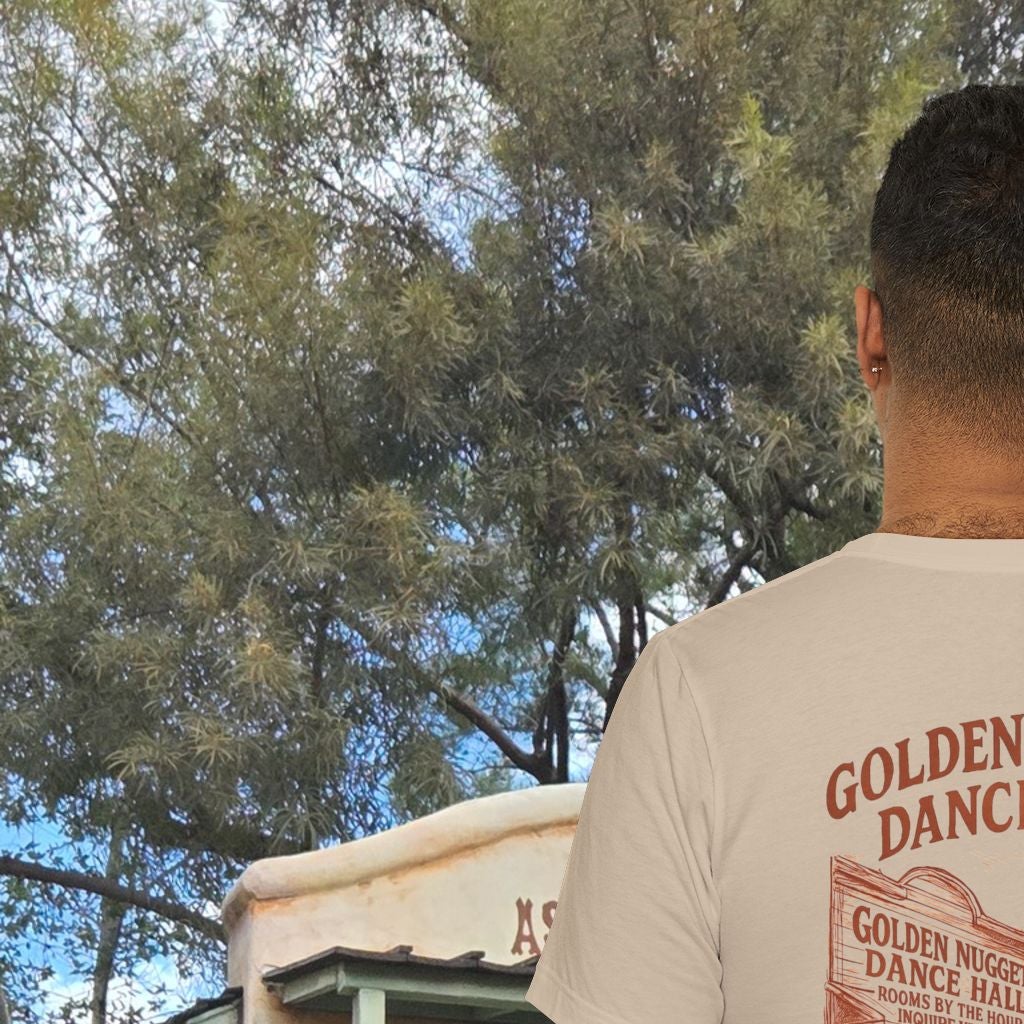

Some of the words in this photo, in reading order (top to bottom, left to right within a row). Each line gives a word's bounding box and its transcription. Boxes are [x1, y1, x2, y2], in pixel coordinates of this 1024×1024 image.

[852, 905, 949, 963] GOLDEN
[865, 949, 961, 997] DANCE
[878, 985, 931, 1010] ROOMS
[935, 996, 954, 1014] BY
[957, 1003, 983, 1021] THE
